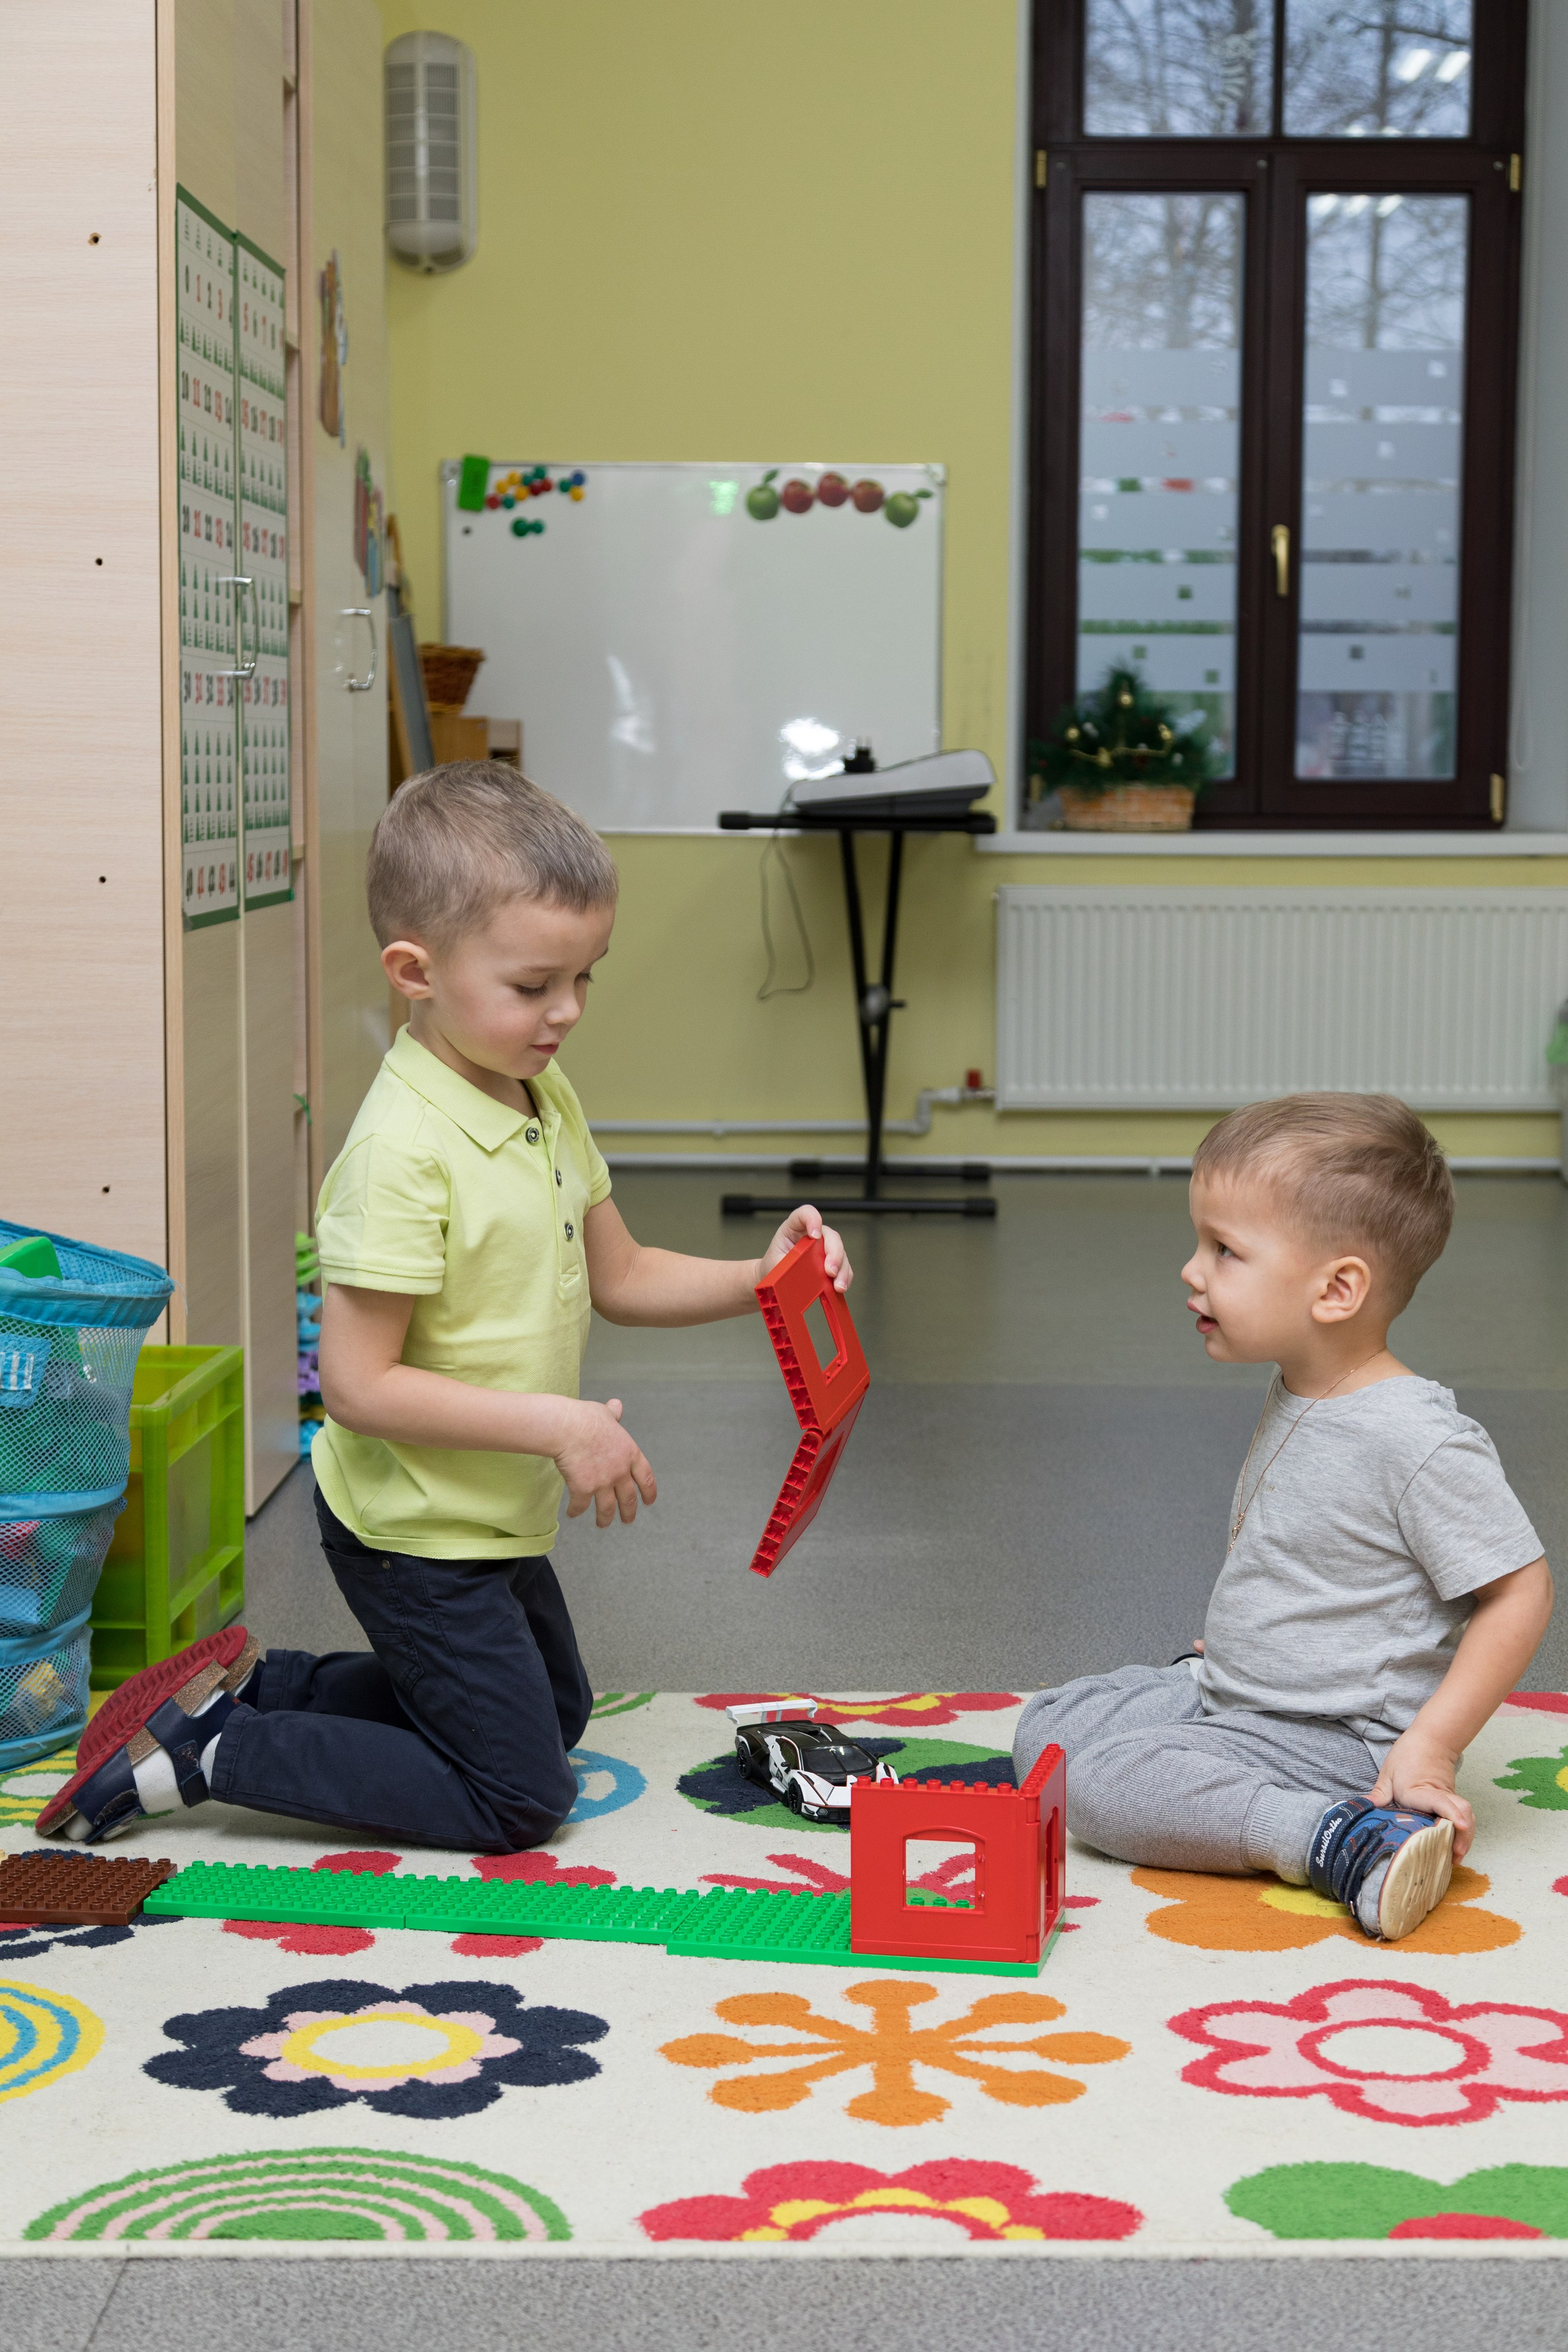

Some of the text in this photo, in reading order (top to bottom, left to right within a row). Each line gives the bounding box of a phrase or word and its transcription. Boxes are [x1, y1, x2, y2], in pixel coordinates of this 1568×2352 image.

[185, 265, 189, 293] 0
[197, 274, 200, 302] 1
[208, 282, 211, 309] 2
[218, 288, 222, 320] 3
[1316, 1817, 1343, 1868] SursilOrtho
